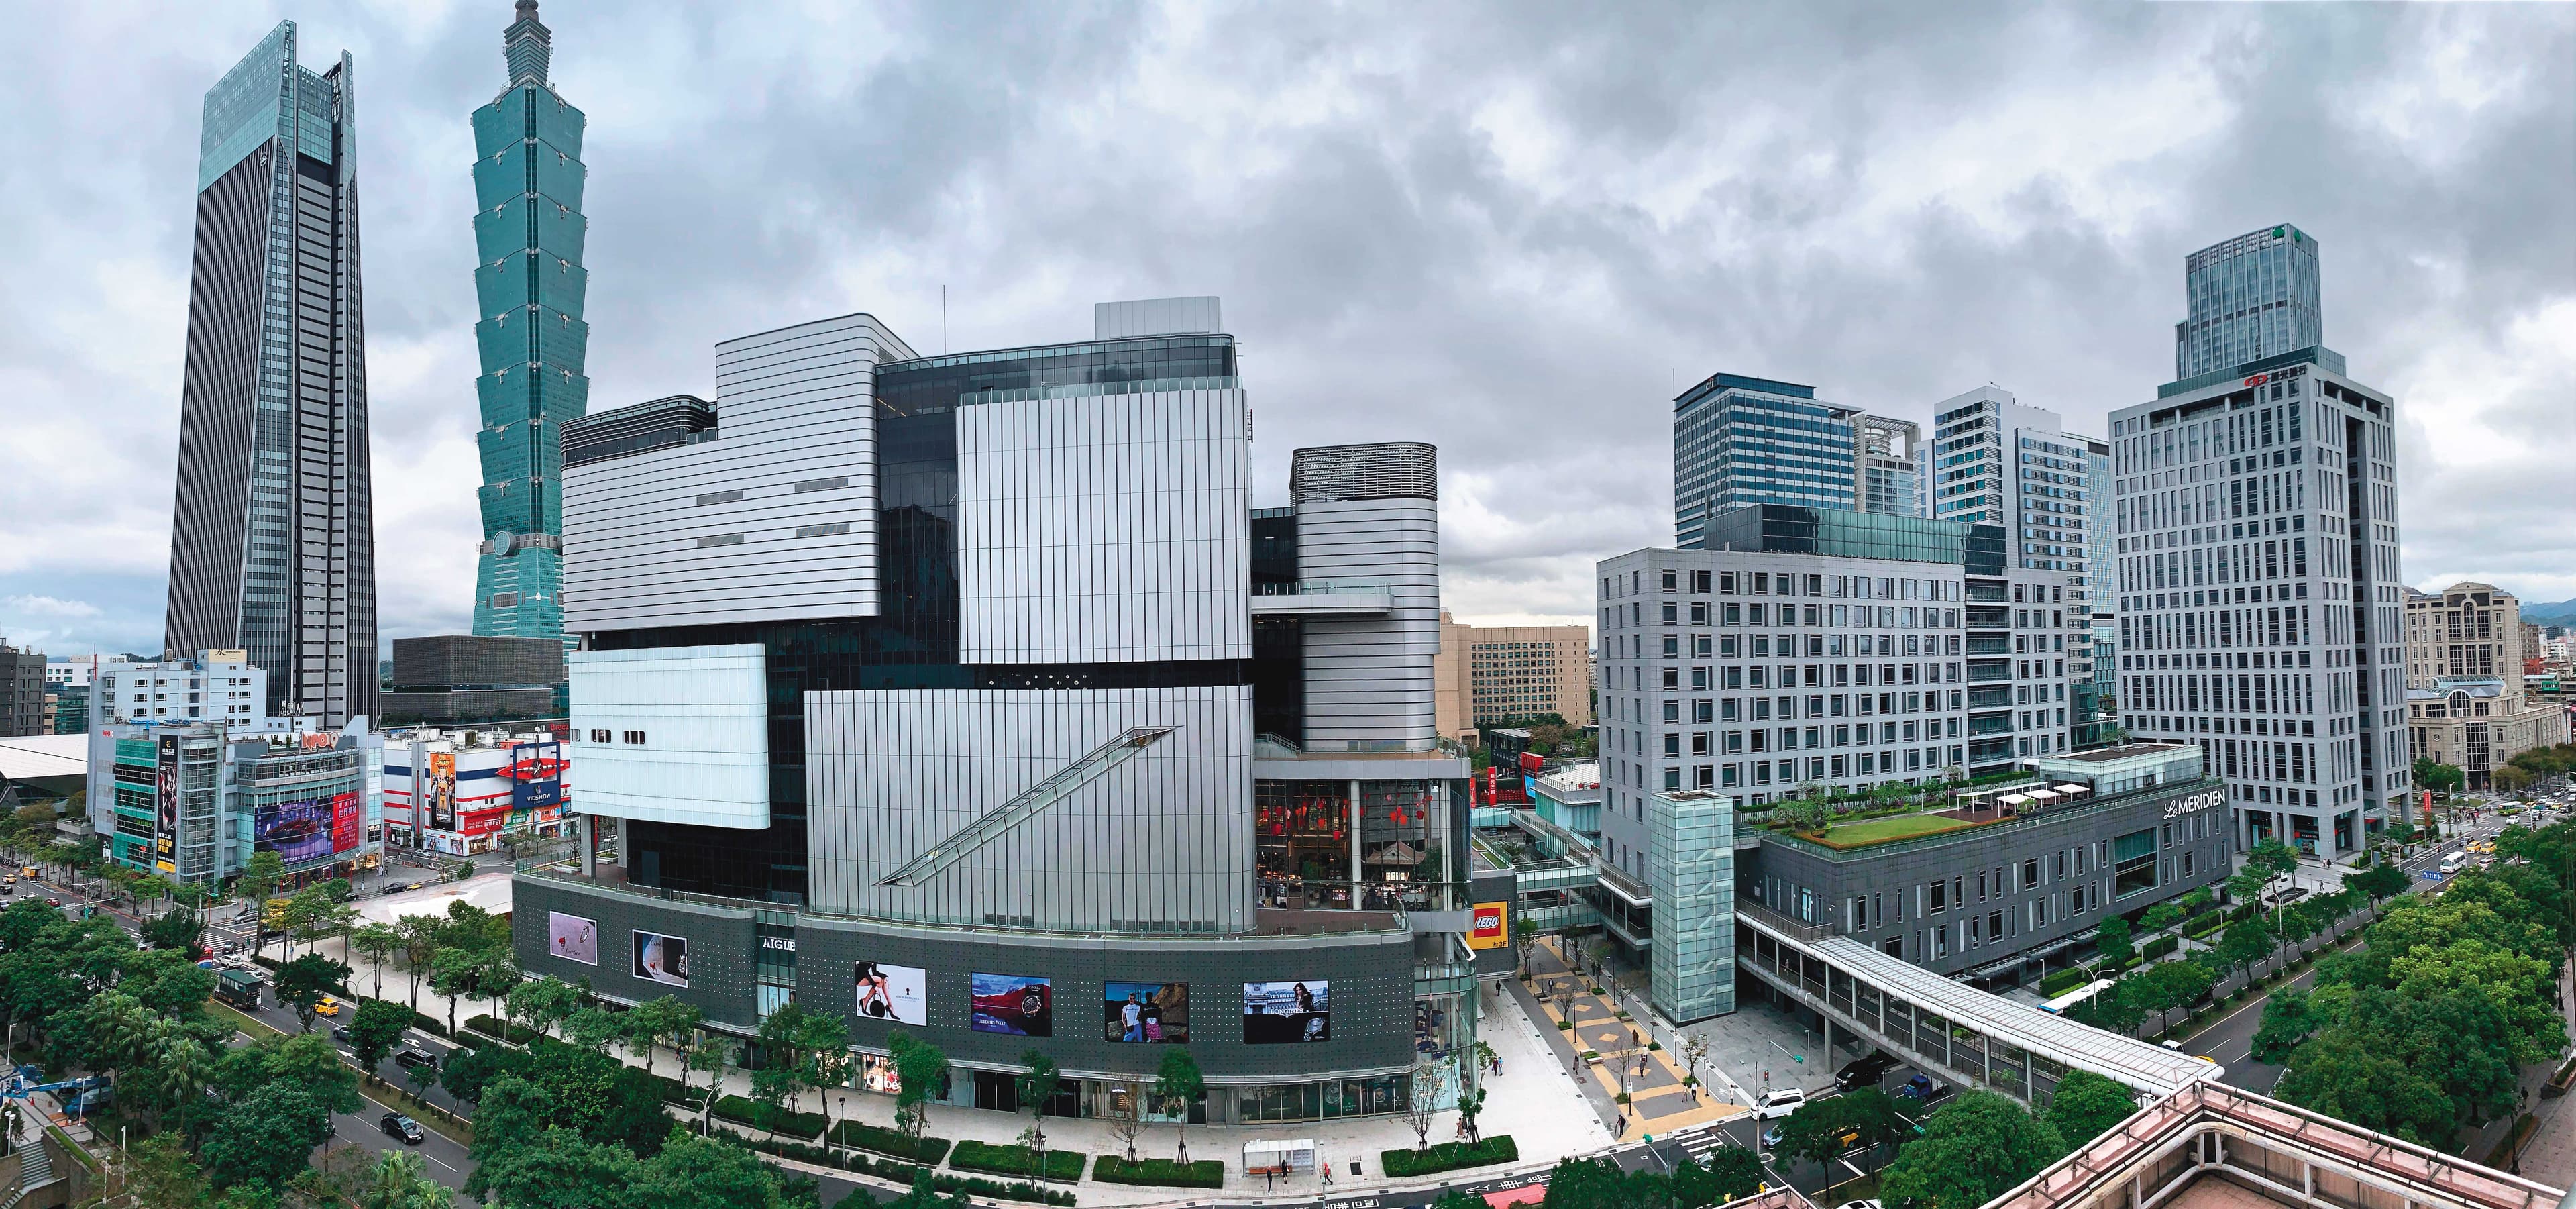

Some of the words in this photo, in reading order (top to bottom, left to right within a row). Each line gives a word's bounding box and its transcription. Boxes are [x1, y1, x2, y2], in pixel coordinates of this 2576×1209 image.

[527, 793, 551, 801] VIESHOW
[2163, 800, 2178, 819] Le
[2178, 789, 2226, 814] MERIDIEN
[1475, 916, 1499, 929] LEGO
[762, 938, 795, 951] AIGLE
[566, 947, 580, 956] Cartier
